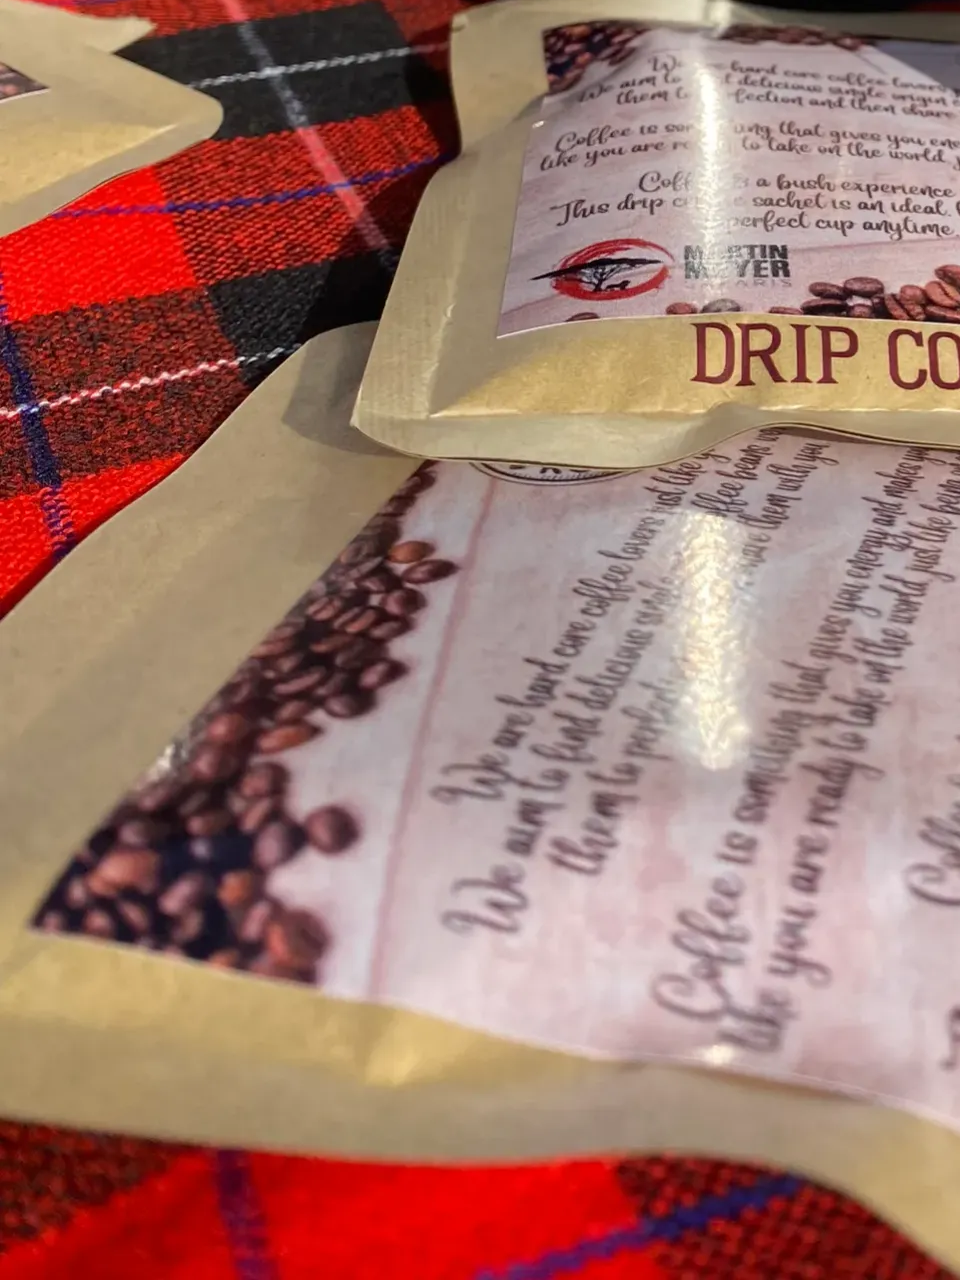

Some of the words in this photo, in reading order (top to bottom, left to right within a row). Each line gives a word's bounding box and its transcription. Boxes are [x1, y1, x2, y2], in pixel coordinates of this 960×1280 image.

[619, 75, 657, 90] aim
[738, 73, 822, 94] delicious
[828, 84, 888, 103] single
[892, 92, 948, 108] origin
[731, 59, 778, 76] hard
[783, 69, 822, 81] core
[827, 72, 888, 88] coffee
[891, 77, 947, 93] lovers
[616, 88, 668, 106] them
[809, 95, 848, 110] and
[850, 97, 897, 115] then
[902, 102, 956, 119] share
[540, 151, 578, 171] like
[584, 147, 628, 168] you
[631, 140, 666, 153] are
[742, 135, 760, 151] to
[767, 137, 812, 156] take
[817, 143, 843, 158] on
[847, 141, 885, 160] the
[555, 124, 631, 154] Coffee
[639, 123, 658, 136] is
[778, 120, 825, 138] that
[829, 128, 882, 144] gives
[886, 133, 926, 150] you
[776, 173, 836, 192] bush
[841, 179, 956, 199] experience
[551, 198, 610, 228] This
[617, 193, 665, 216] drip
[752, 190, 829, 210] sachet
[831, 197, 851, 211] is
[857, 200, 886, 215] an
[729, 209, 812, 234] perfect
[814, 218, 856, 237] cup
[684, 244, 788, 261] MRTIN
[690, 322, 859, 387] DRIP
[650, 460, 706, 487] like
[766, 462, 819, 492] with
[874, 461, 925, 501] makes
[736, 491, 803, 530] them
[860, 495, 908, 527] and
[597, 516, 665, 561] lovers
[846, 527, 913, 580] energy
[572, 564, 637, 617] coffee
[829, 582, 882, 618] you
[553, 619, 597, 659] core
[809, 614, 859, 664] gives
[494, 656, 571, 708] hard
[565, 627, 655, 712] delicious
[766, 658, 833, 705] that
[492, 711, 534, 749] are
[528, 710, 605, 764] find
[429, 752, 509, 806] We
[584, 760, 645, 787] to
[733, 709, 832, 825] something
[799, 755, 886, 828] ready
[504, 797, 566, 856] aim
[546, 790, 640, 876] them
[714, 829, 759, 866] is
[788, 832, 831, 895] are
[441, 863, 529, 934] We
[650, 870, 751, 1020] Coffee
[767, 903, 834, 989] you
